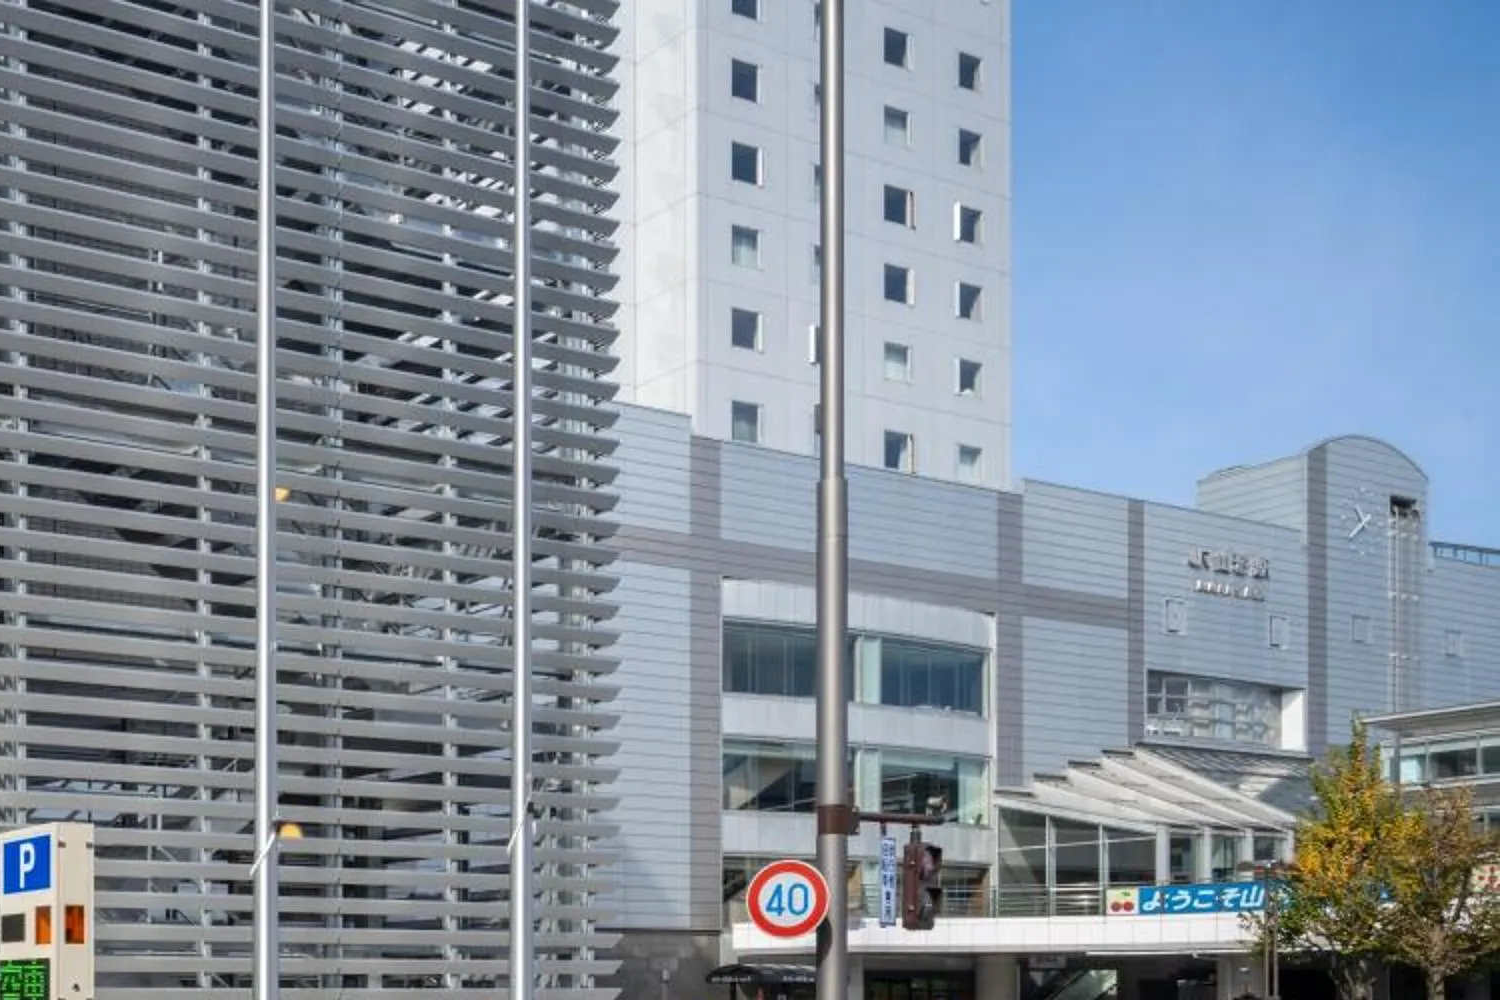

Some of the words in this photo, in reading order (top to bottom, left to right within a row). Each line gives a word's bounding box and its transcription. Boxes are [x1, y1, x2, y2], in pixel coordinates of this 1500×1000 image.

[19, 842, 36, 888] P
[765, 883, 809, 917] 40
[1141, 882, 1290, 914] ようこそ山
